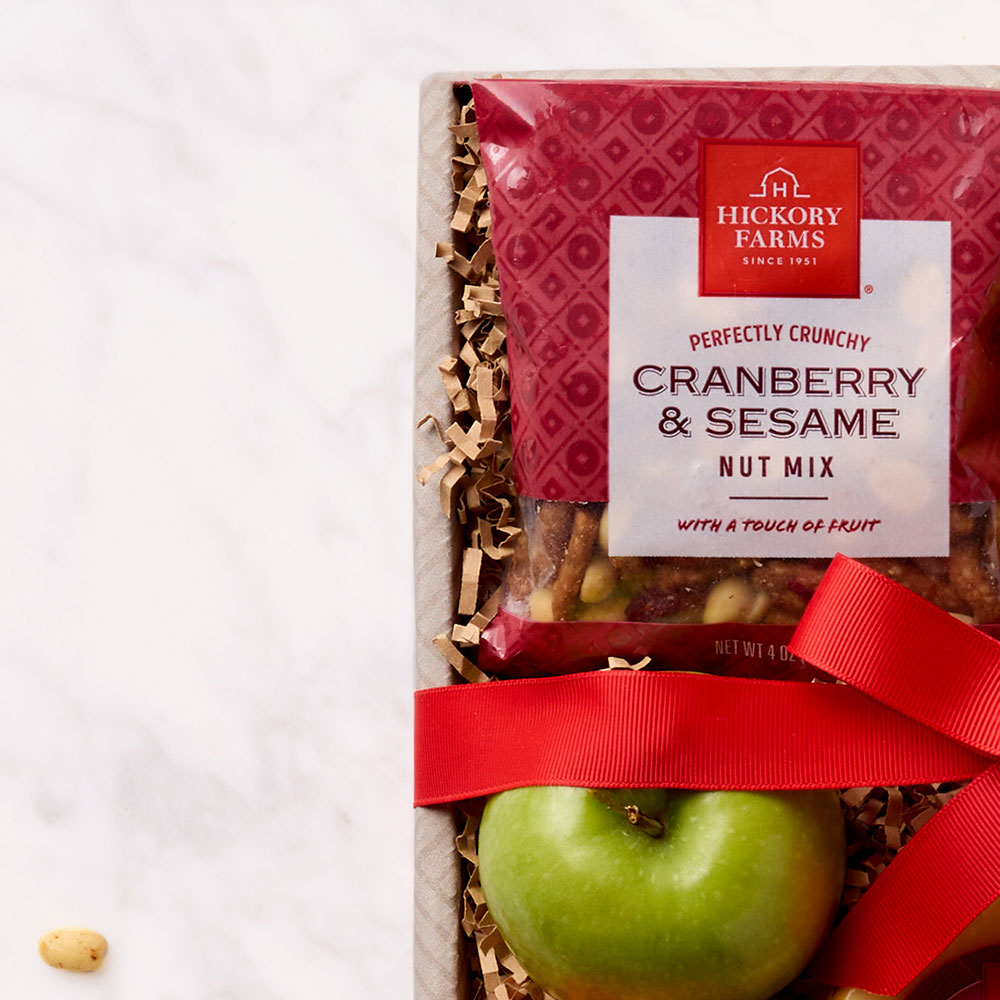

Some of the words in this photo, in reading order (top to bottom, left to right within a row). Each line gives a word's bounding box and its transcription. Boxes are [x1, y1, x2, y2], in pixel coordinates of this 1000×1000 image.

[773, 182, 787, 197] H
[717, 206, 842, 226] HICKORY
[735, 230, 825, 249] FARMS
[743, 256, 784, 265] SINCE
[789, 257, 818, 266] 1951
[689, 324, 783, 351] PERFECTLY
[789, 324, 872, 353] CRUNCHY
[633, 364, 928, 398] CRANBERRY
[658, 406, 692, 438] &
[705, 406, 900, 439] SESAME
[719, 456, 771, 478] NUT
[784, 456, 835, 478] MIX
[677, 518, 722, 533] WITH
[725, 519, 737, 532] A
[741, 518, 799, 533] TOUCH
[802, 518, 826, 533] OF
[827, 518, 882, 533] FRUIT
[715, 639, 739, 655] NET
[743, 640, 764, 659] WT
[767, 644, 776, 660] 4
